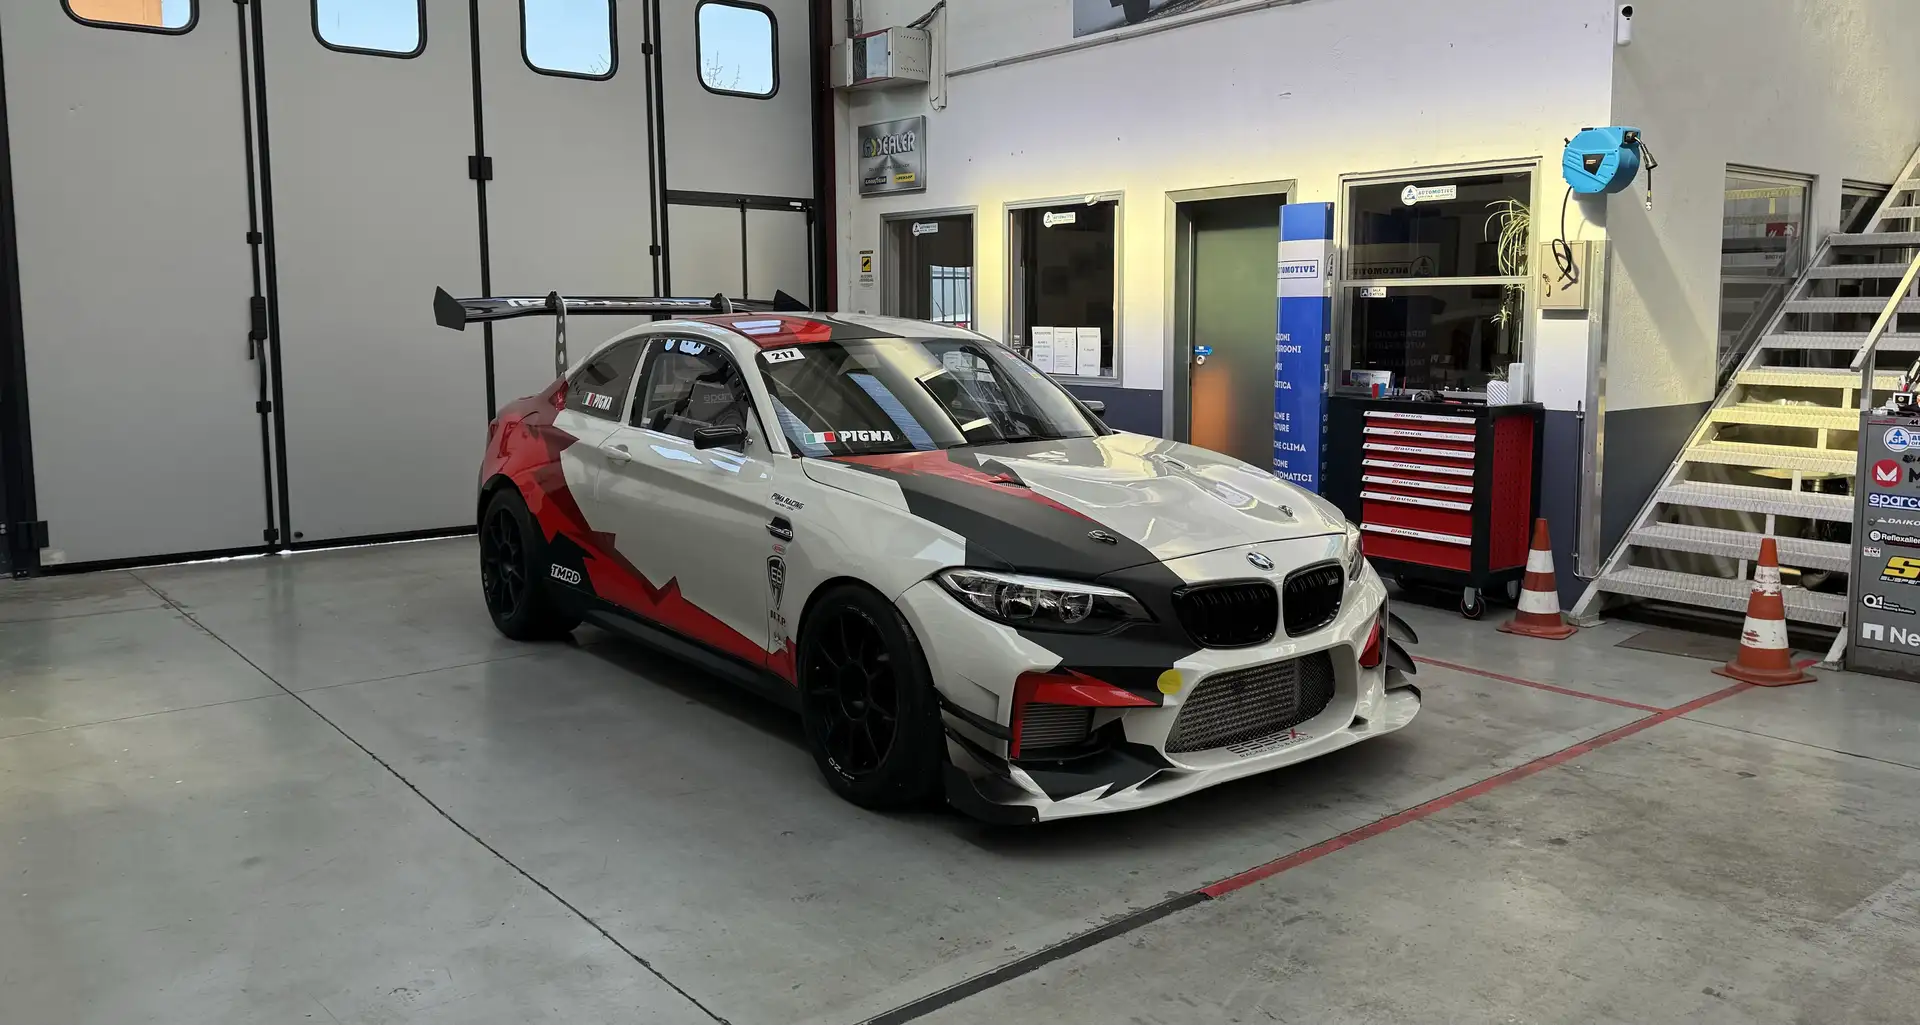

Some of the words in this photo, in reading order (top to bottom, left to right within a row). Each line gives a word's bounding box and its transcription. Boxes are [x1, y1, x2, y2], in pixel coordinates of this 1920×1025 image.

[771, 351, 795, 360] 217
[593, 393, 611, 411] PIGNA
[838, 430, 895, 442] PIGNA
[1282, 442, 1307, 453] CLIMA
[550, 563, 581, 585] TMRD
[1863, 594, 1884, 609] Q1
